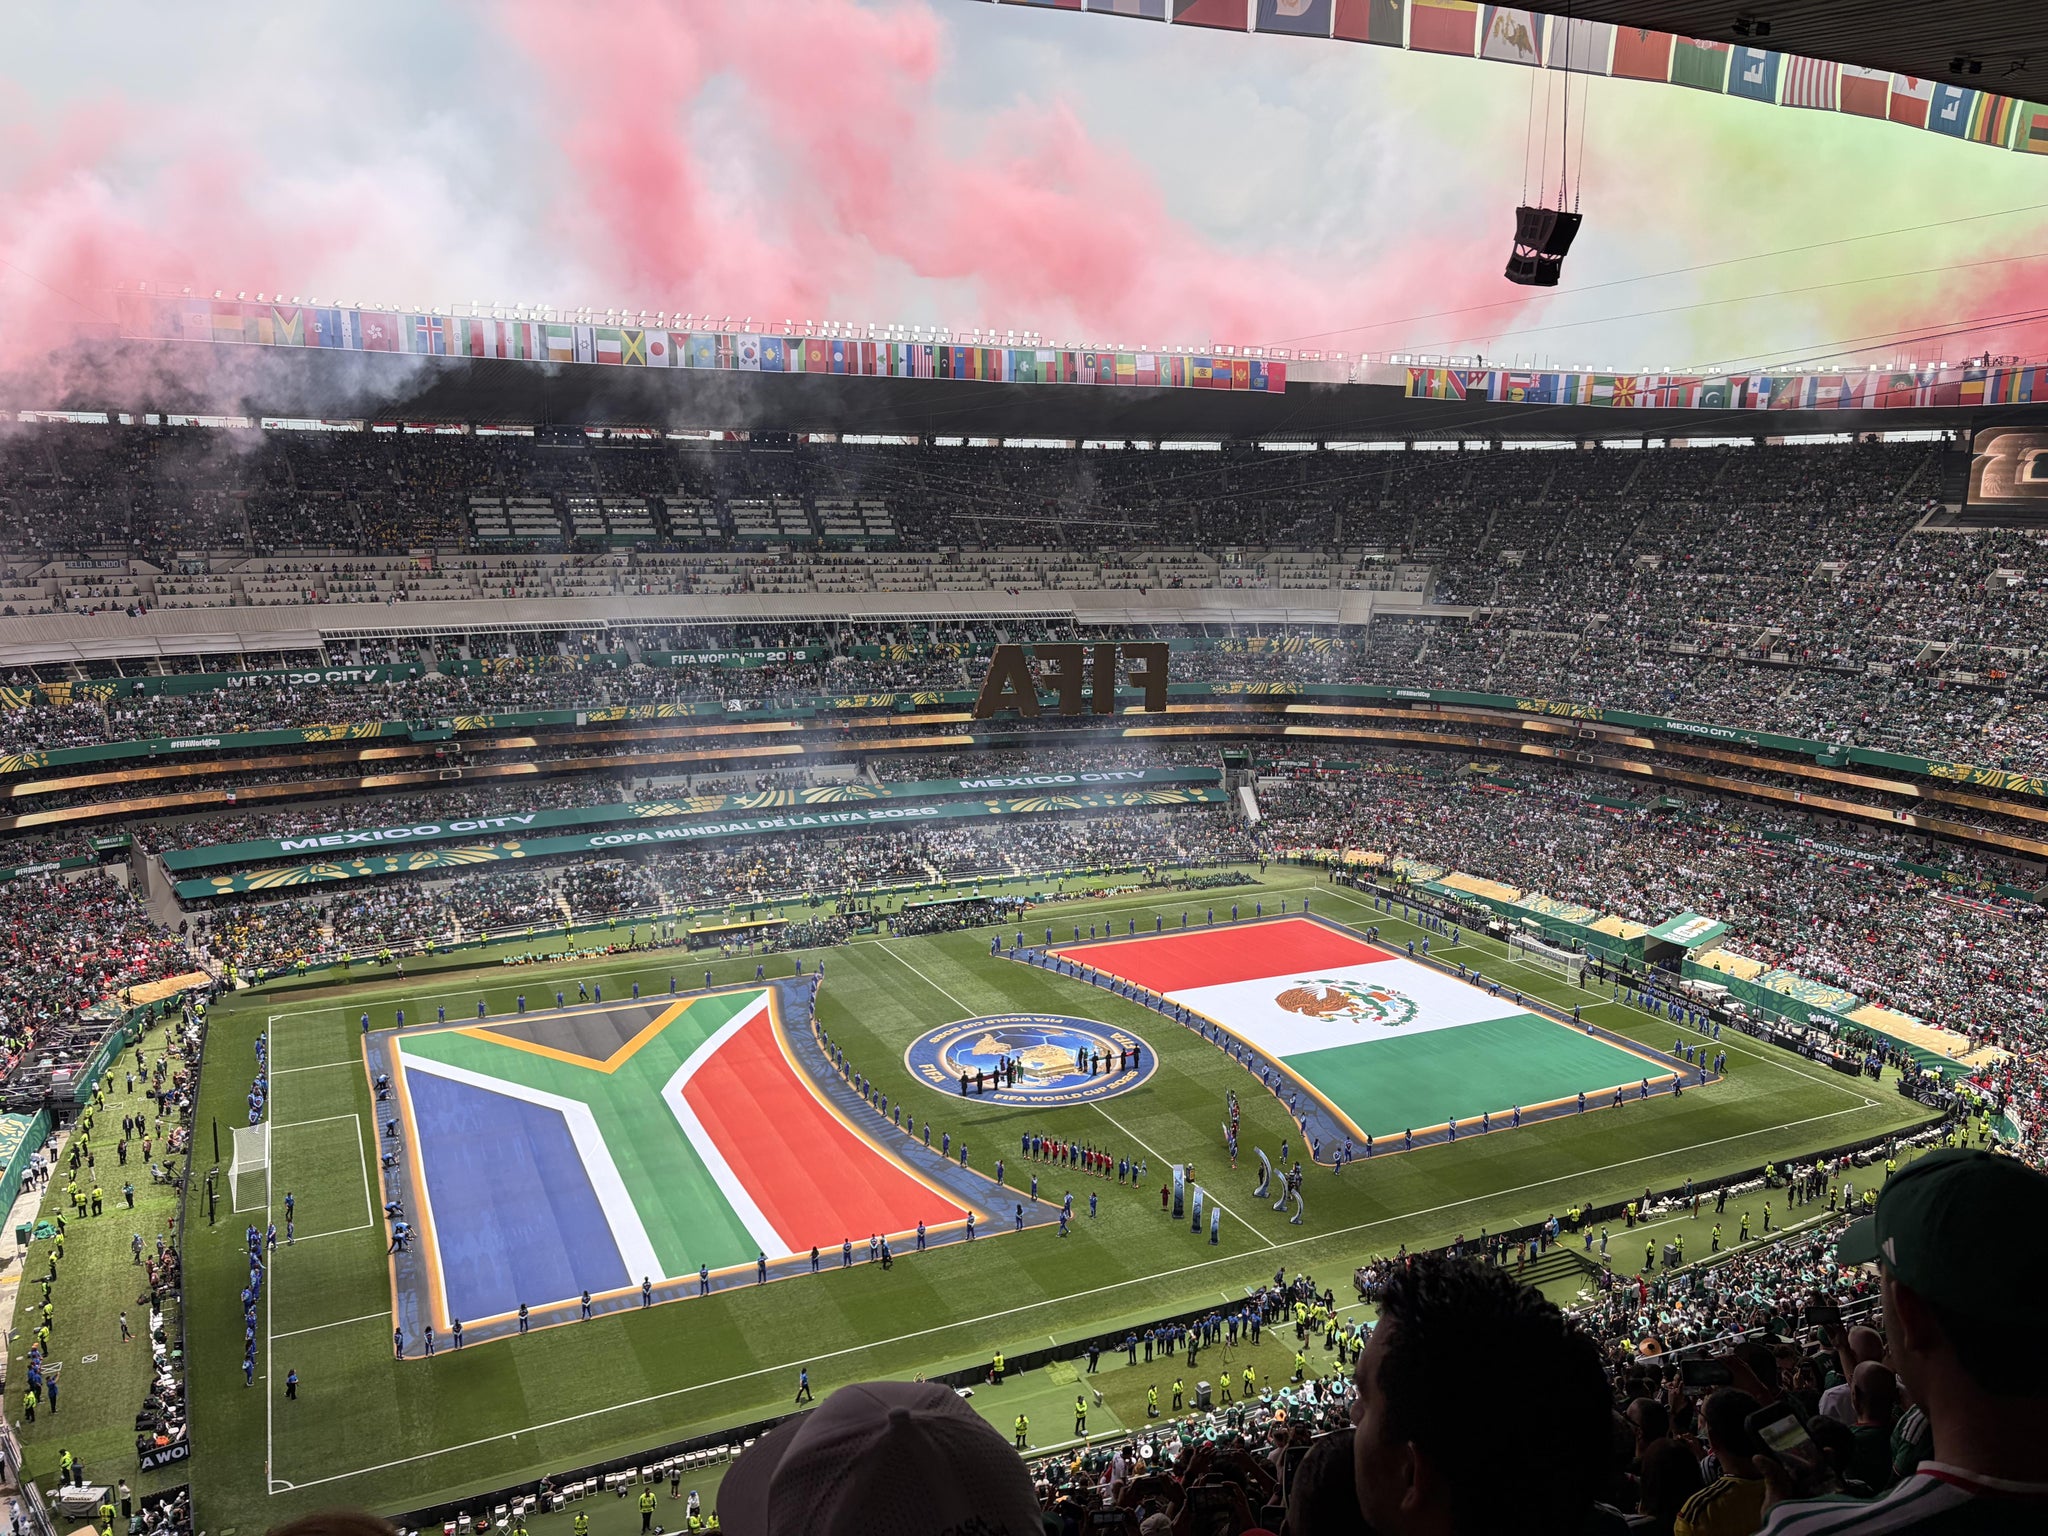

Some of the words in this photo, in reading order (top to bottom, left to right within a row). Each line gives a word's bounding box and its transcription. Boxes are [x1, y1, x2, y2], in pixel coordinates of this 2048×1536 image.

[671, 655, 697, 665] FIFA
[766, 651, 806, 661] 206
[325, 669, 378, 682] CITY
[1666, 721, 1708, 733] MEXICO
[1710, 728, 1736, 738] CITY
[170, 738, 220, 748] #FIFAWorldCup
[959, 775, 1076, 789] MEXICO
[1080, 771, 1145, 782] CITY
[280, 825, 441, 850] MEXICO
[449, 814, 536, 831] CITY
[589, 830, 654, 847] COPA
[655, 821, 756, 840] MUNDIAL
[758, 818, 785, 830] DE
[788, 815, 814, 827] LA
[816, 811, 866, 825] FIFA
[868, 806, 938, 819] 2026
[1812, 843, 1840, 854] WORLD
[1840, 848, 1856, 857] CUP
[15, 862, 60, 876] #FIFAWorldCup
[918, 1063, 948, 1083] FIFA
[994, 1093, 1027, 1101] FIFA
[1029, 1093, 1083, 1102] WORLD
[1082, 1086, 1106, 1097] CUP
[1106, 1070, 1139, 1090] 2026
[140, 1456, 155, 1469] A
